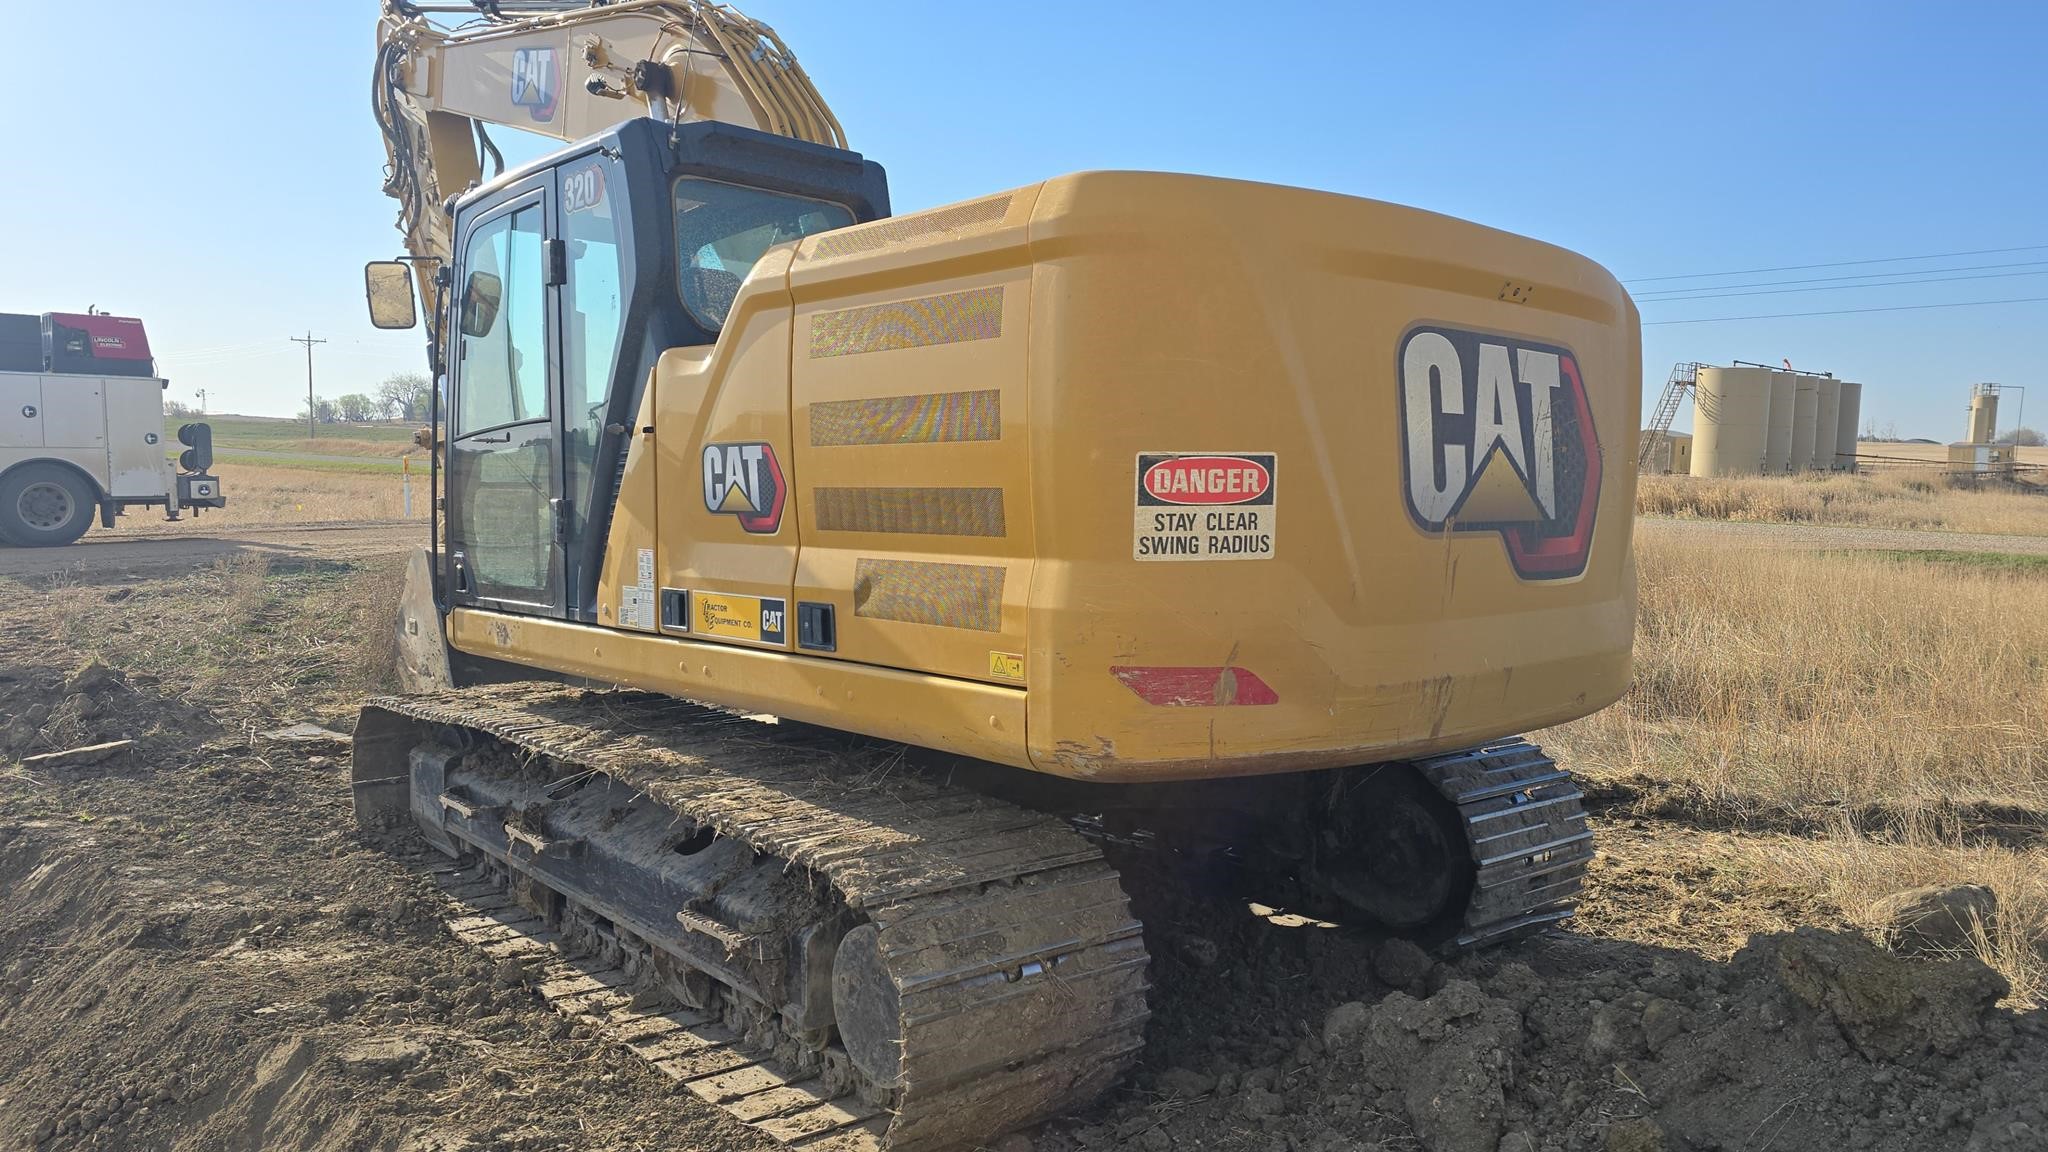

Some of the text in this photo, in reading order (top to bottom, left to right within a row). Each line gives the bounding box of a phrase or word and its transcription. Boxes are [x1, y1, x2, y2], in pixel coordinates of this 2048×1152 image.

[512, 49, 550, 104] CAT
[564, 169, 594, 212] 320
[1403, 331, 1560, 523] CAT
[703, 445, 762, 511] CAT
[1153, 468, 1260, 494] DANGER
[1154, 512, 1258, 532] STAY CLEAR
[1139, 535, 1270, 555] SWING RADIUS
[708, 613, 741, 630] EQUIPMENT
[743, 620, 752, 629] CO.
[762, 609, 782, 633] CAT
